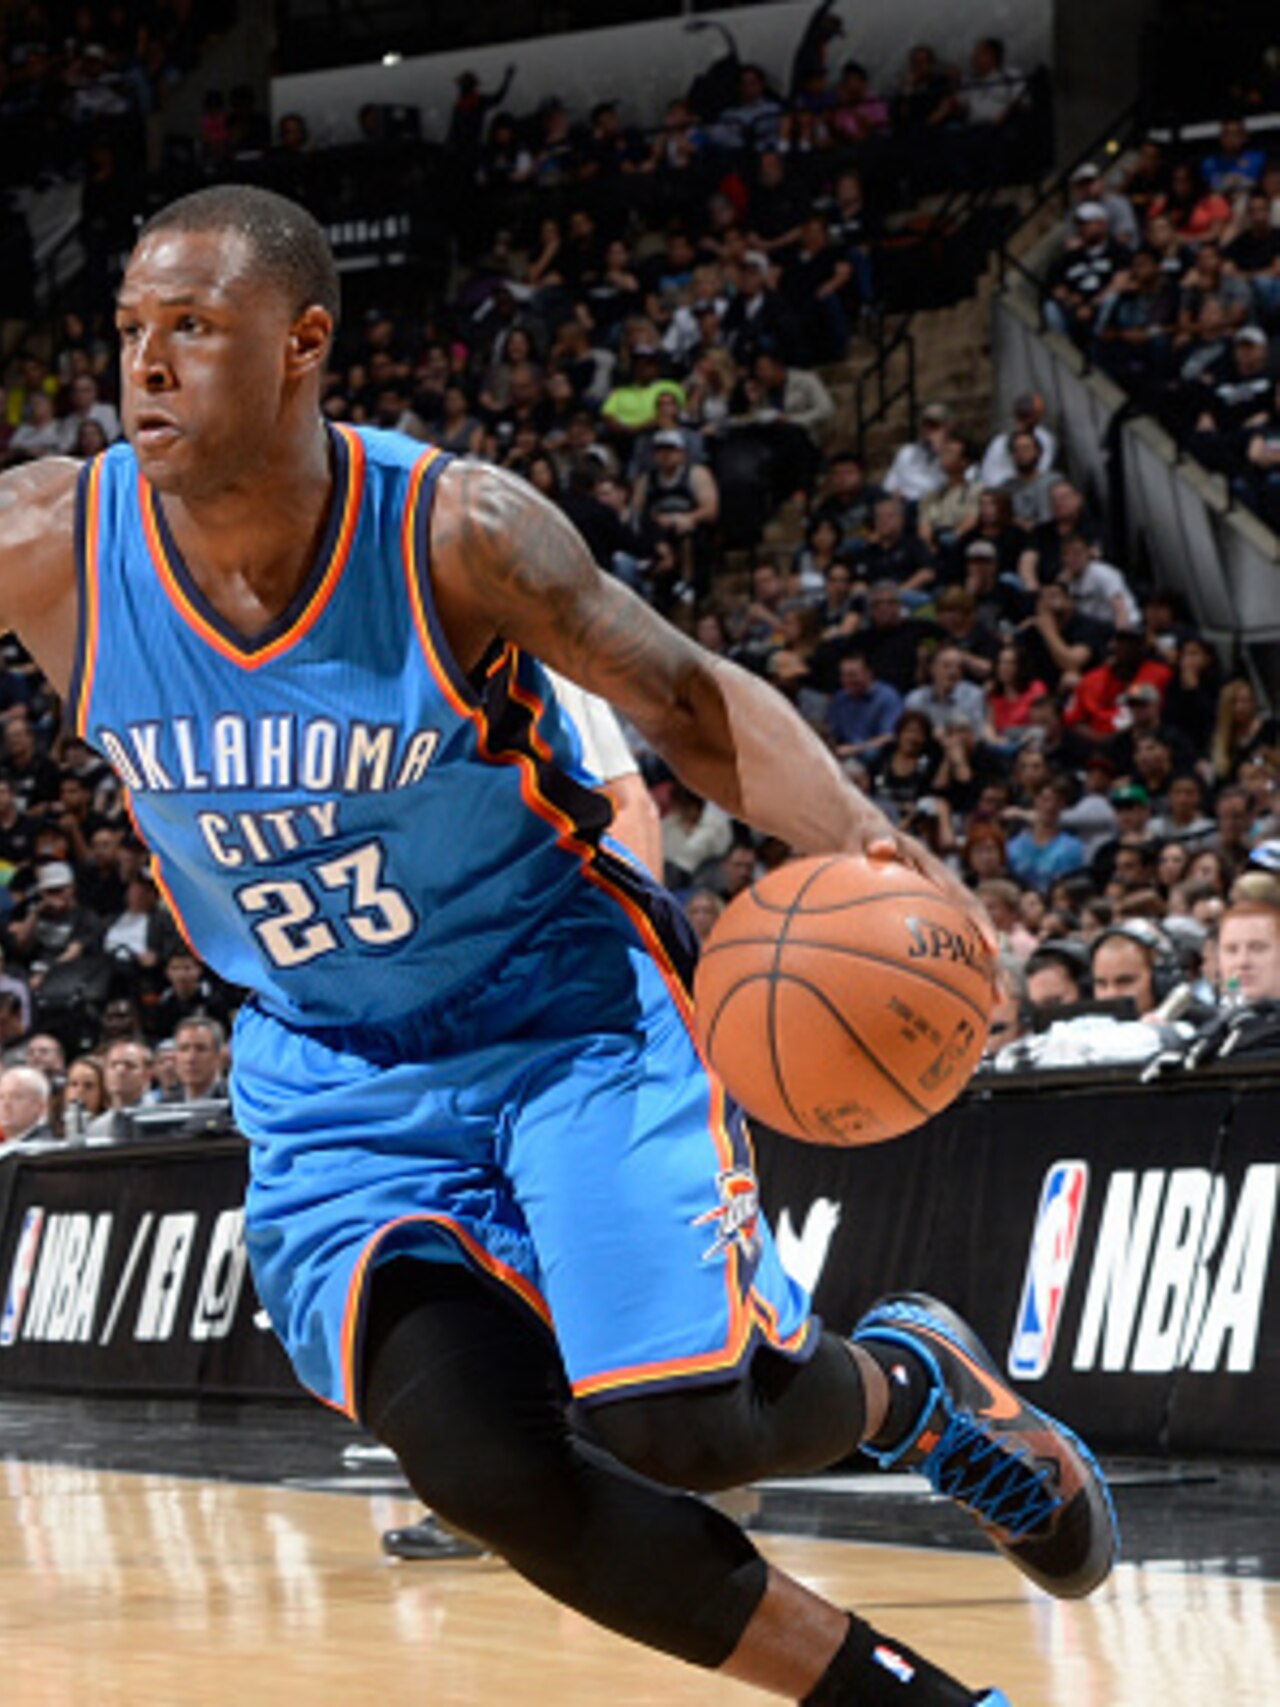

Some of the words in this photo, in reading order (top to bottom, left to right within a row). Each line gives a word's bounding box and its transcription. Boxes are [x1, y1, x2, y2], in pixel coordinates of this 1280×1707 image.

[98, 713, 441, 792] OKLAHOMA
[196, 802, 339, 867] CITY
[234, 838, 418, 968] 23
[22, 1212, 113, 1341] NBA
[1073, 1164, 1280, 1373] NBA
